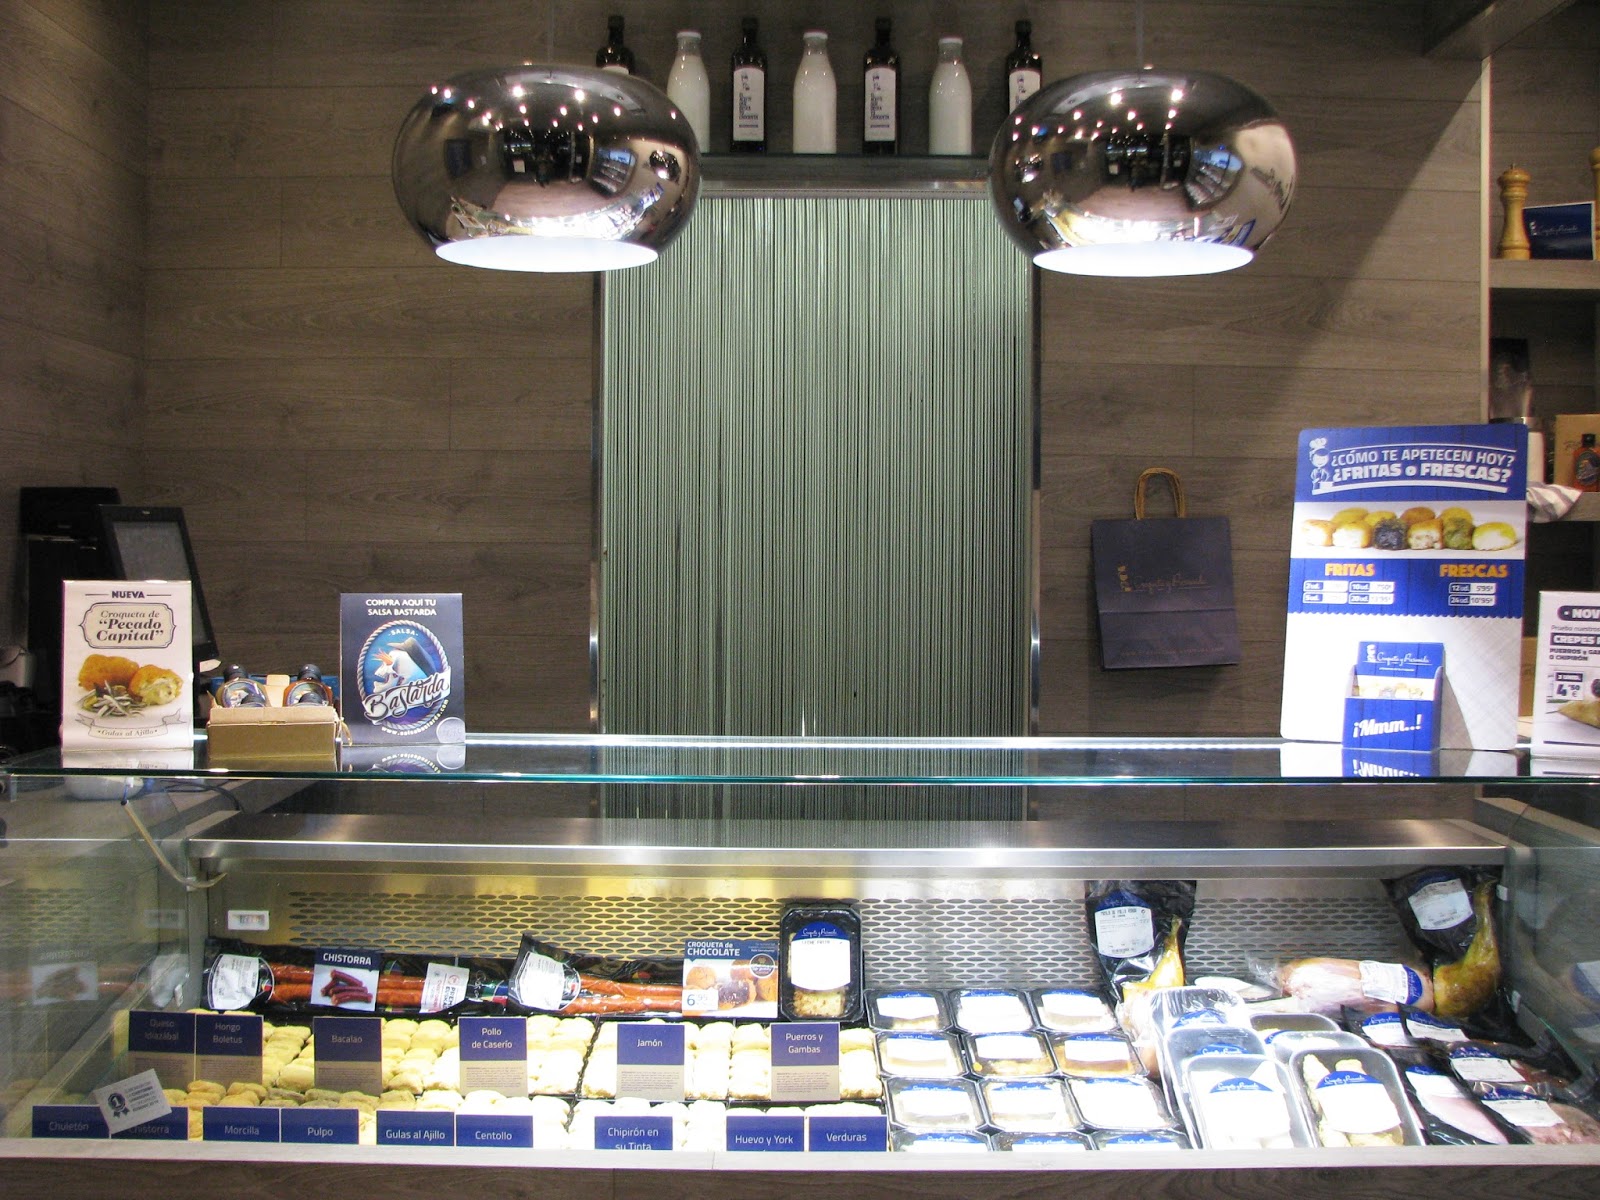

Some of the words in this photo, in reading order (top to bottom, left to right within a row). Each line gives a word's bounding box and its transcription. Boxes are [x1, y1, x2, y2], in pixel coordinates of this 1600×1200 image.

[1331, 450, 1378, 466] ¿CÓMO
[1382, 450, 1397, 461] TE
[1401, 449, 1472, 462] APETECEN
[1476, 452, 1515, 467] HOY?
[1333, 463, 1402, 482] ¿FRITAS
[1420, 463, 1512, 483] FRESCAS?
[1324, 563, 1375, 576] FRITAS
[1439, 564, 1508, 578] FRESCAS
[402, 598, 423, 606] AQUÍ
[101, 610, 145, 619] Croqueta
[149, 610, 160, 618] de
[1553, 635, 1596, 644] CREPES
[687, 941, 723, 949] CROQUETA
[687, 948, 740, 956] CHOCOLATE
[323, 953, 371, 965] CHISTORRA
[150, 1019, 174, 1028] Queso
[215, 1022, 240, 1033] Hongo
[482, 1028, 502, 1036] Pollo
[213, 1035, 243, 1044] Boletus
[332, 1035, 362, 1043] Bacalao
[785, 1033, 816, 1041] Puerros
[818, 1034, 823, 1042] y
[472, 1040, 482, 1049] de
[483, 1040, 512, 1049] Caserío
[637, 1038, 663, 1047] Jamón
[788, 1045, 821, 1054] Gambas
[49, 1121, 89, 1131] Chuletón
[225, 1125, 259, 1135] Morcilla
[308, 1127, 333, 1138] Pulpo
[385, 1129, 411, 1139] Gulas
[413, 1130, 421, 1138] al
[423, 1130, 445, 1141] Ajillo
[475, 1131, 512, 1140] Centollo
[608, 1127, 645, 1138] Chipirón
[735, 1135, 764, 1144] Huevo
[766, 1137, 771, 1146] y
[774, 1135, 793, 1144] York
[826, 1133, 867, 1142] Verduras
[629, 1142, 651, 1150] Tinta
